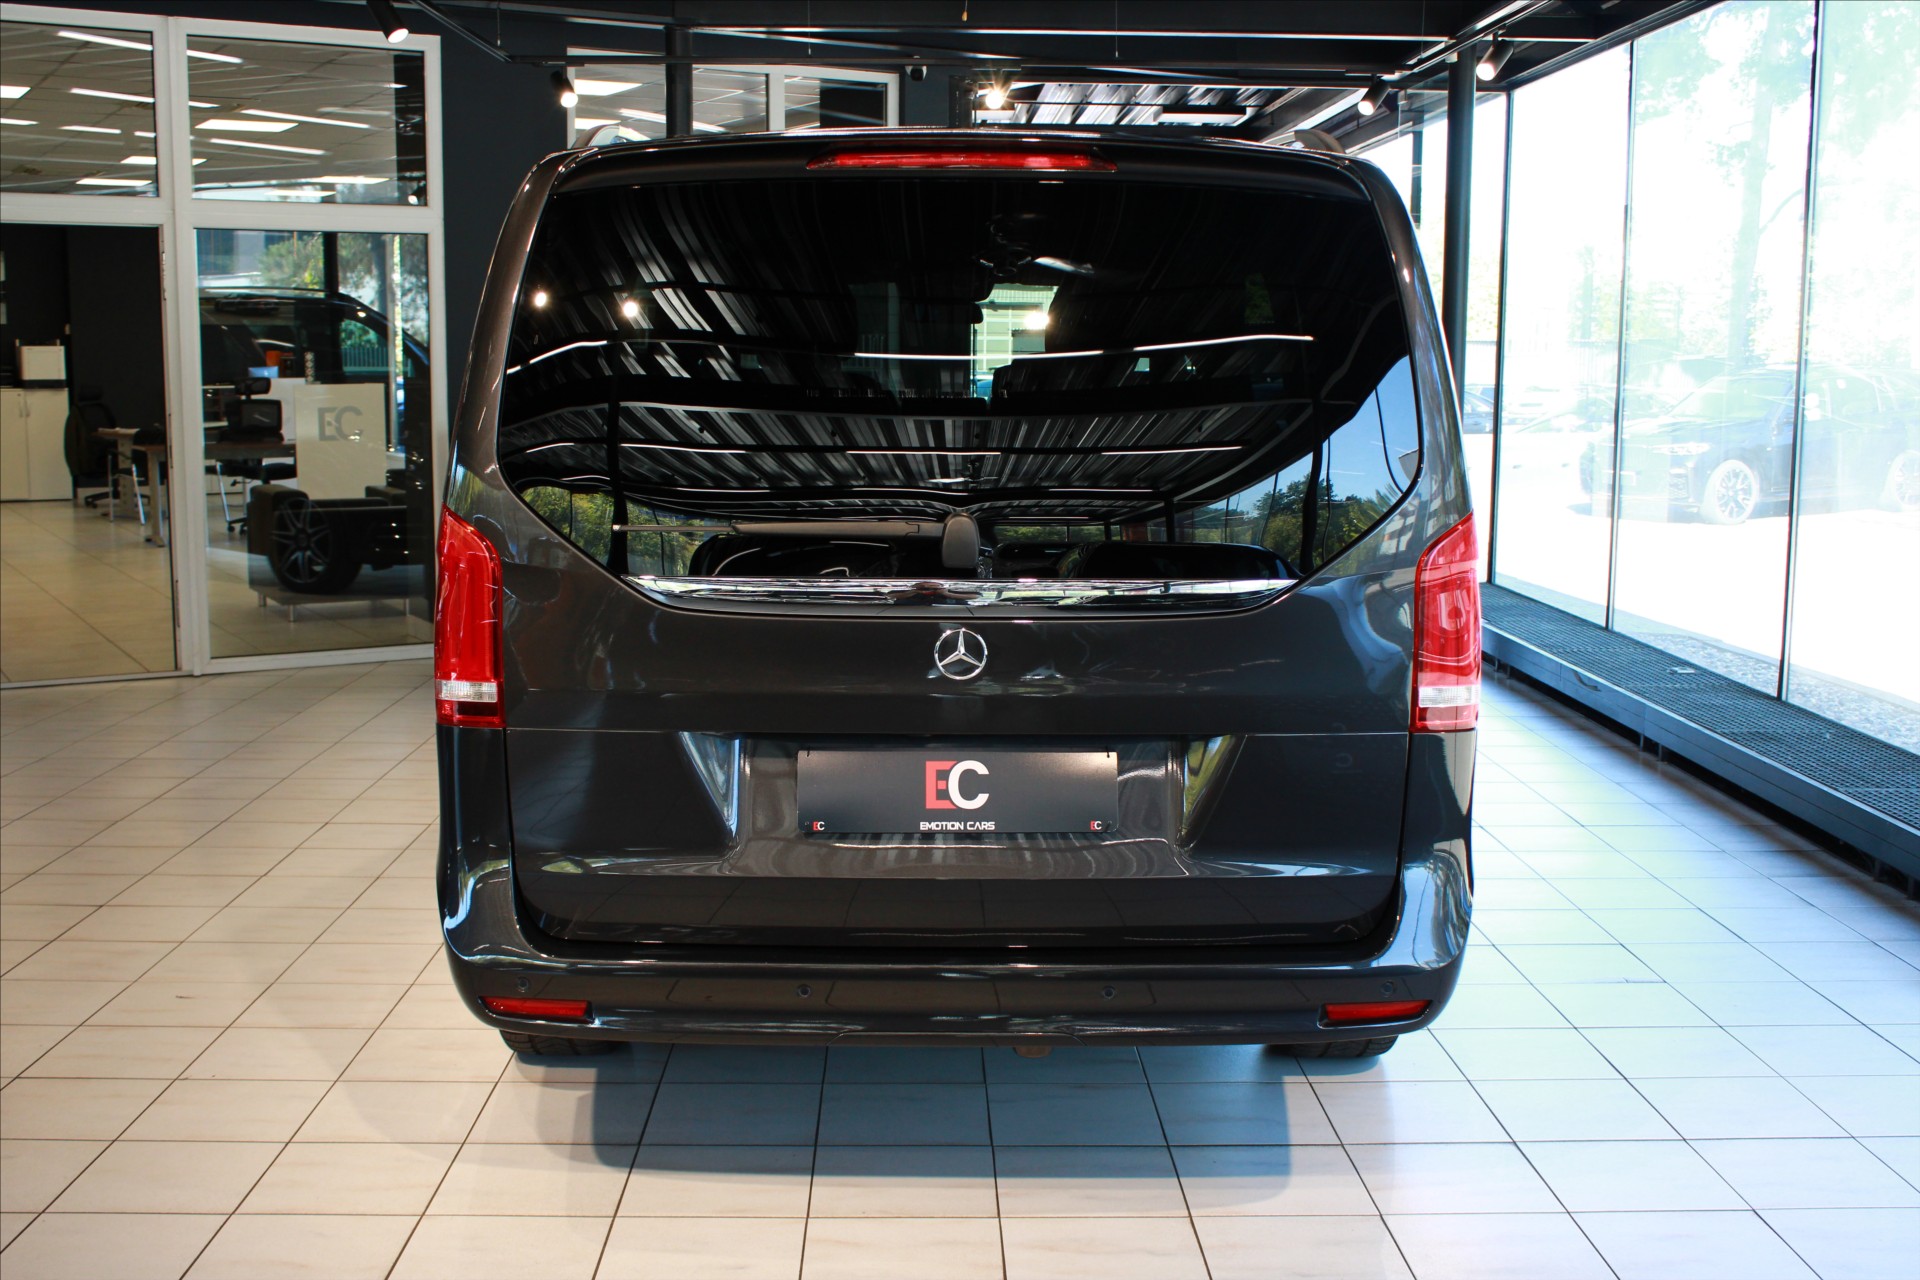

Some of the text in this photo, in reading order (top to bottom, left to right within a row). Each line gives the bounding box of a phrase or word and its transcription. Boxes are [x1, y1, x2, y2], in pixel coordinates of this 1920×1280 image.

[317, 405, 364, 442] EC
[925, 760, 990, 810] EC
[813, 821, 825, 831] EC
[919, 821, 996, 831] EMOTION CARS
[1090, 820, 1102, 830] EC
